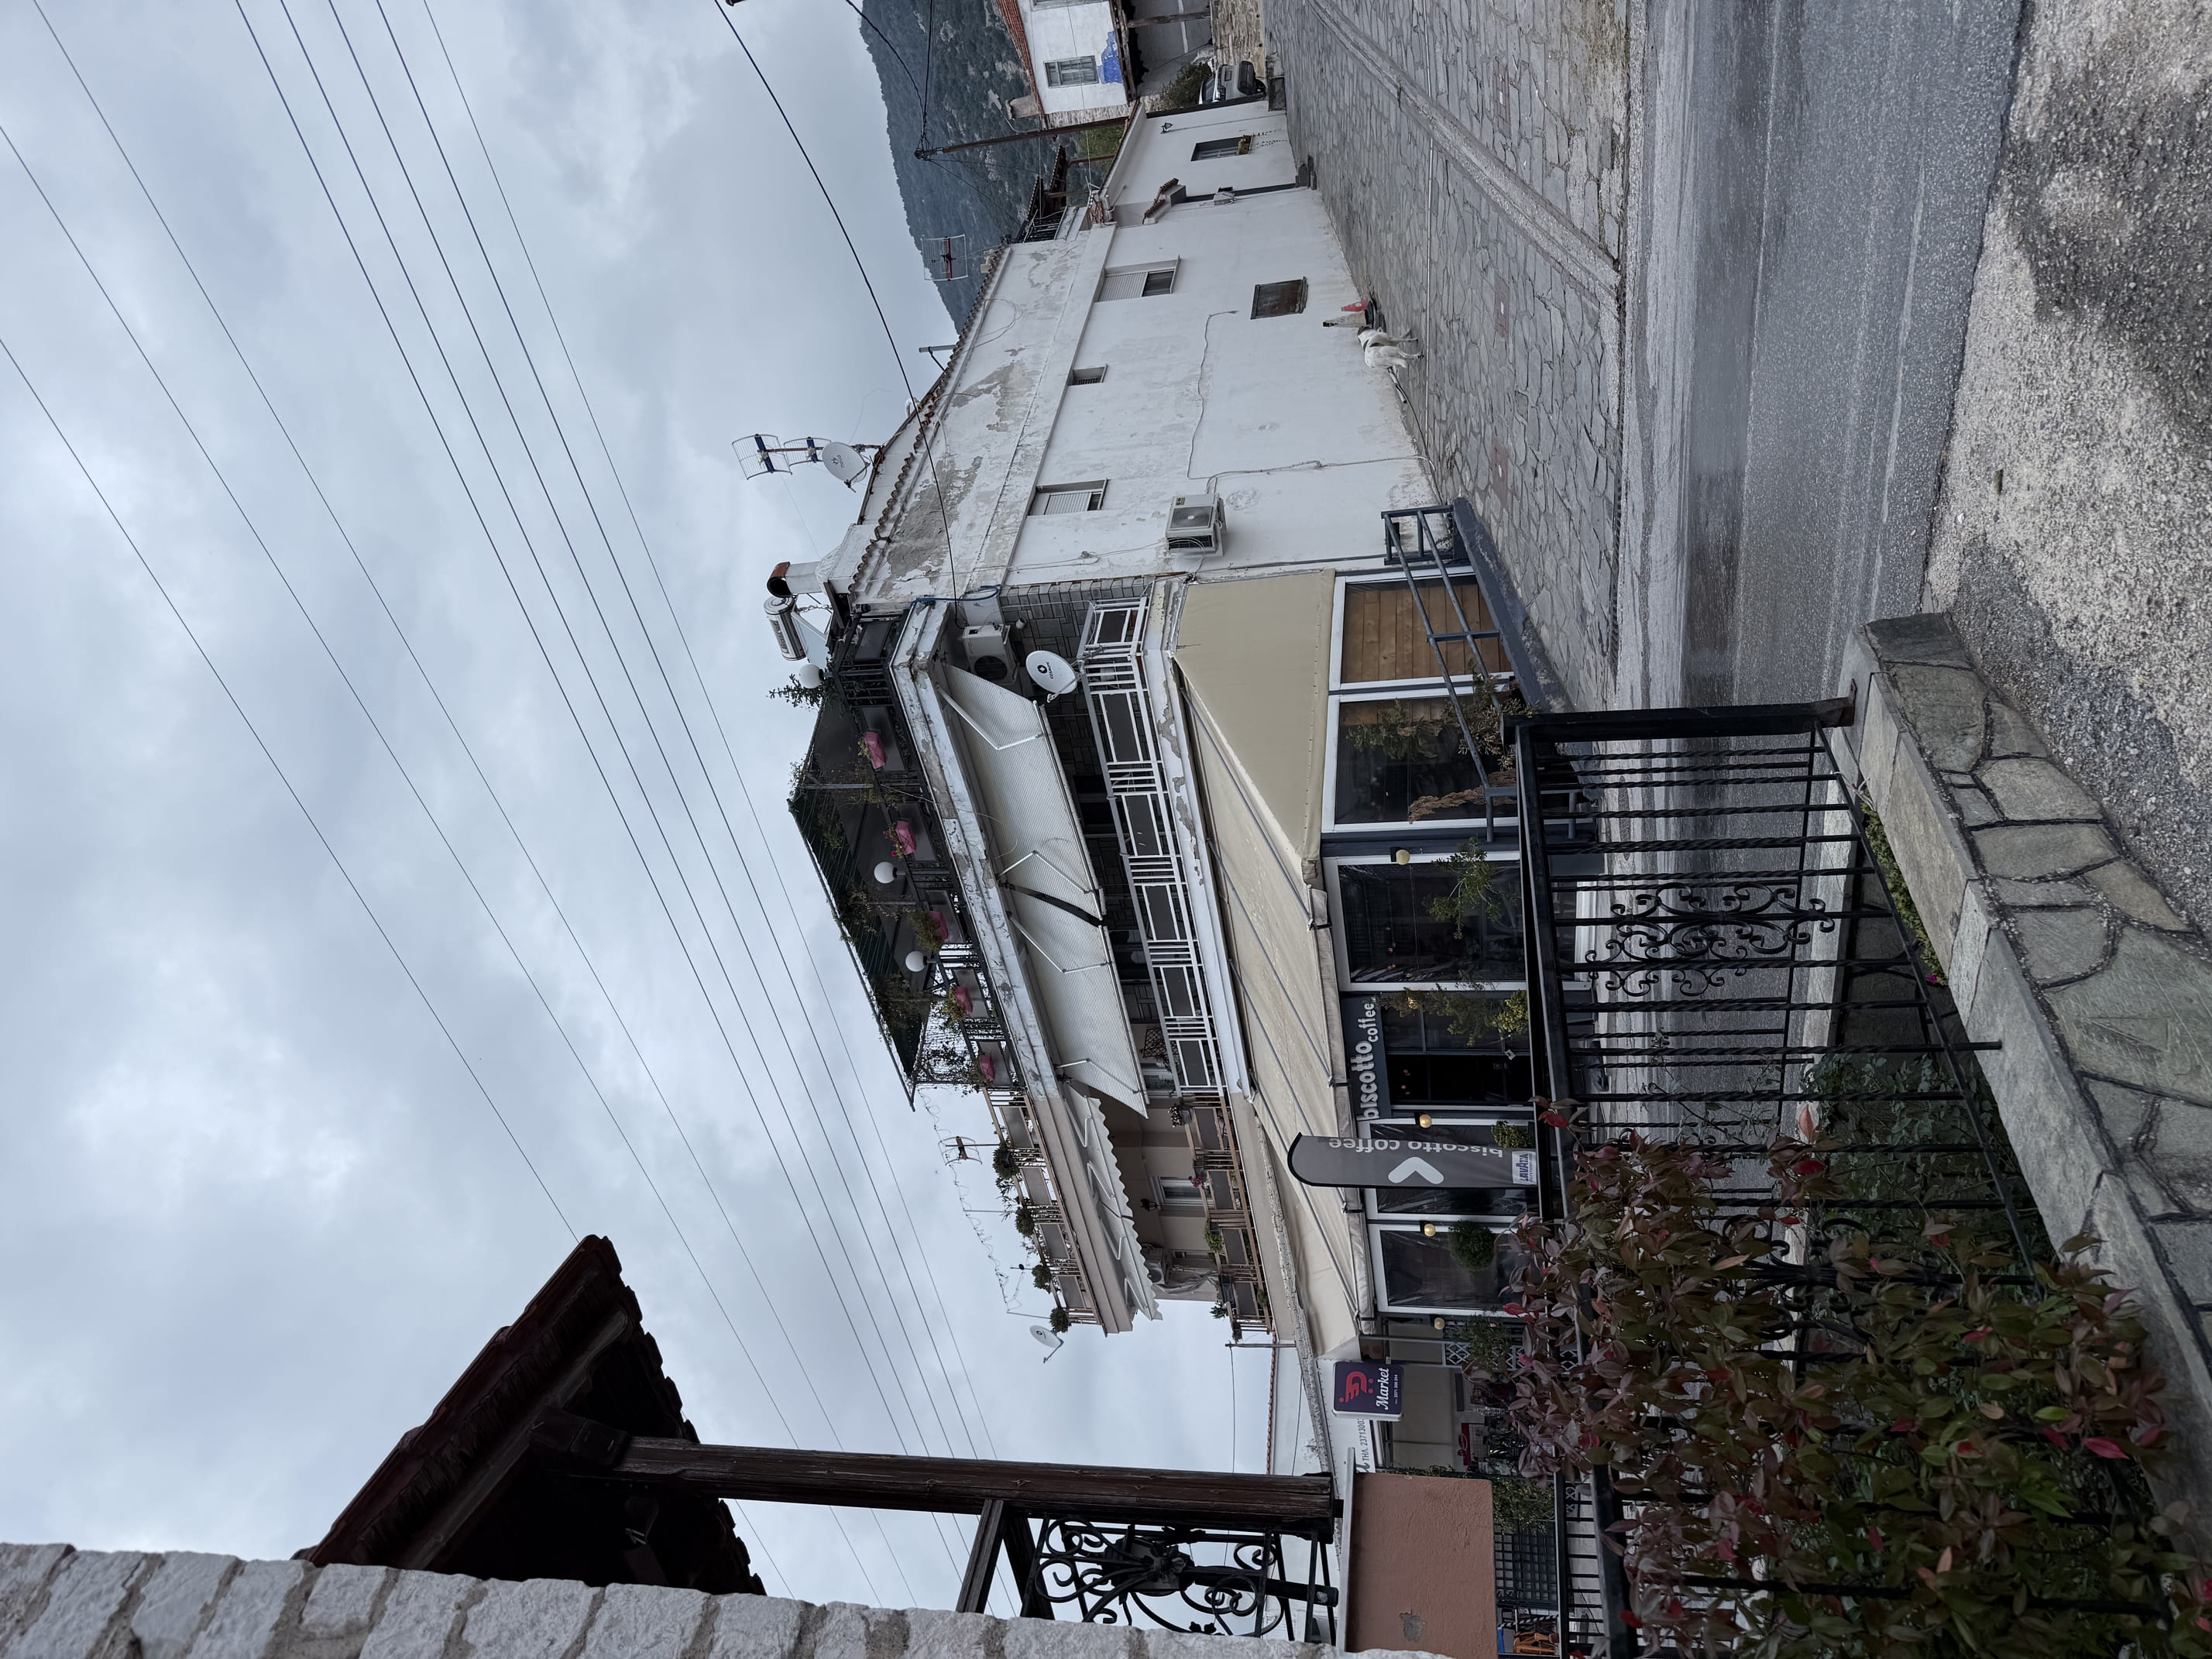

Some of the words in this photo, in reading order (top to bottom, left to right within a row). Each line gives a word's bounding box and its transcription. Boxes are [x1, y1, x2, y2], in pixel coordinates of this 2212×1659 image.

[836, 455, 845, 468] nova
[1358, 1003, 1379, 1042] coffee
[1350, 1040, 1379, 1121] biscotto
[1328, 1138, 1400, 1153] coffee
[1407, 1141, 1503, 1158] biscotto
[1376, 1367, 1389, 1410] Market
